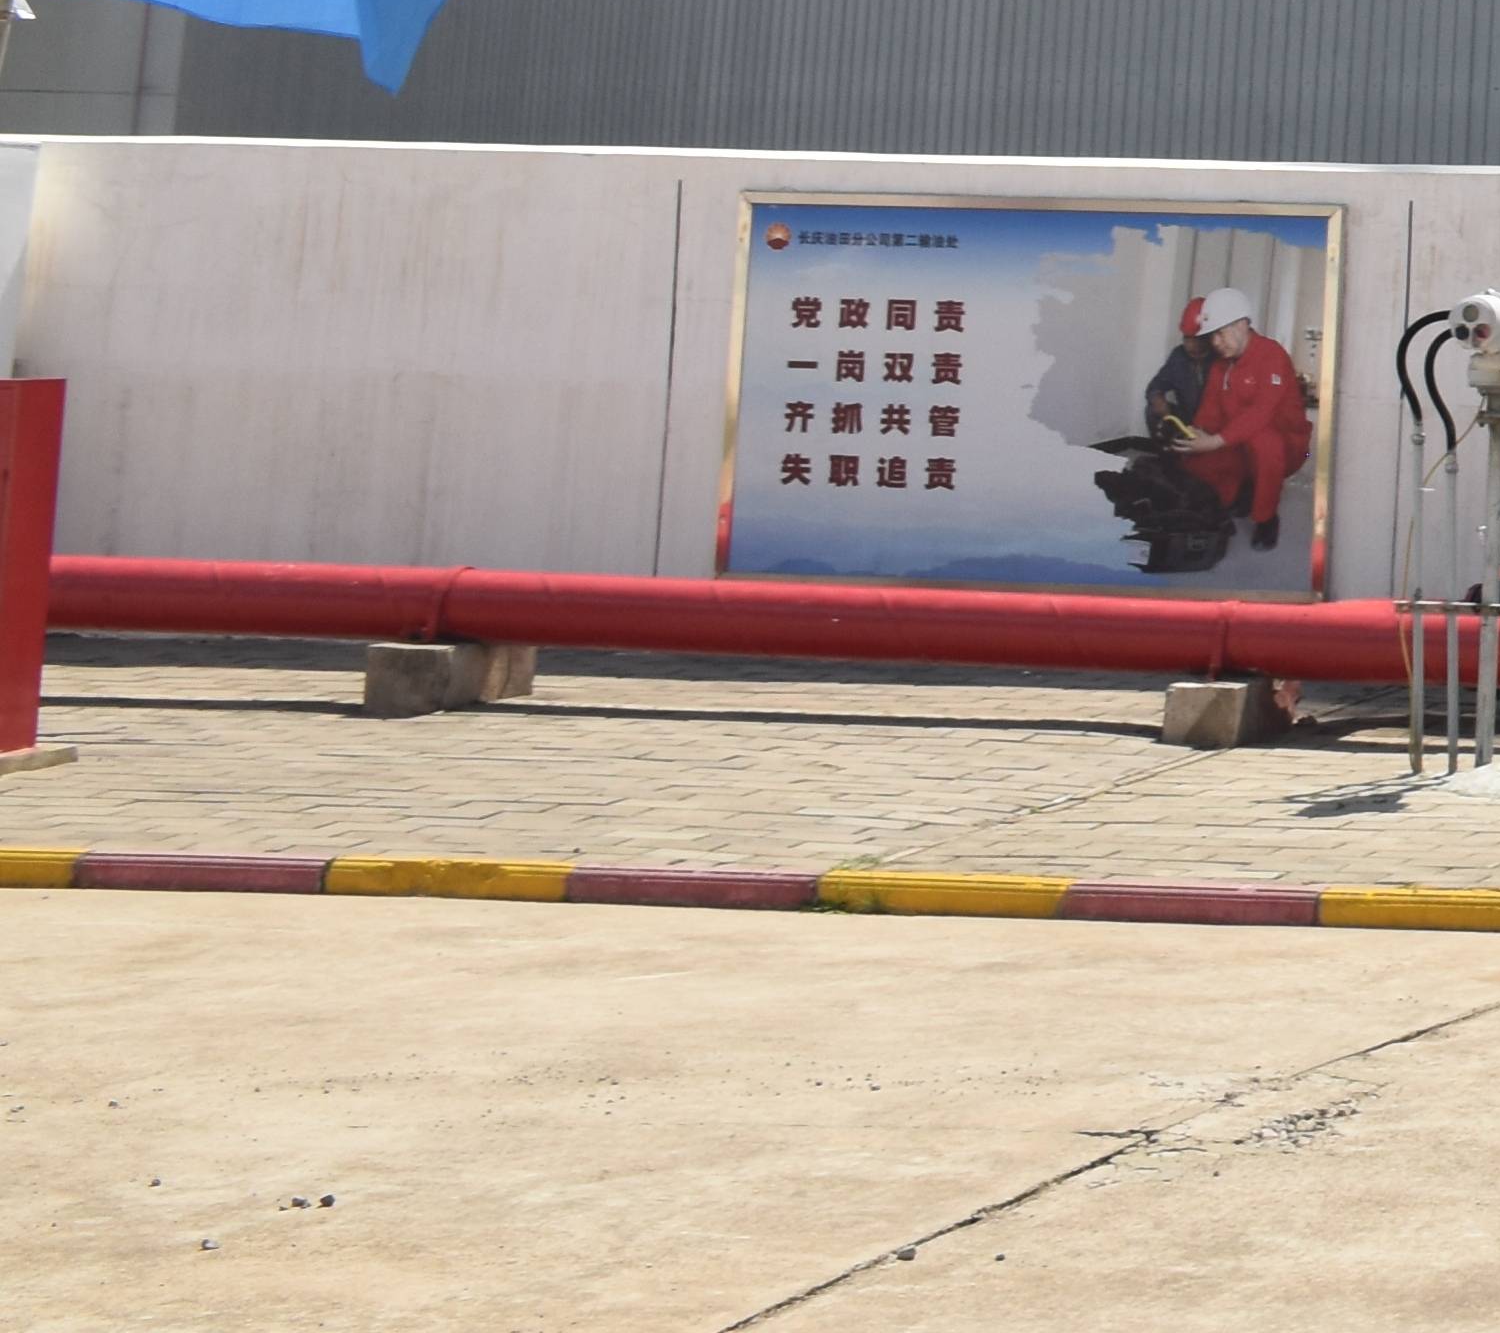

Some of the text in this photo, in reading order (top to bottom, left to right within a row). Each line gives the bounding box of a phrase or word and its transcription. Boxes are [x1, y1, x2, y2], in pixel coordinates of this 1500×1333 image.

[791, 296, 966, 333] 党政同责
[787, 349, 963, 386] 一岗双责
[784, 400, 960, 438] 齐抓共管
[781, 453, 957, 491] 失职追责
